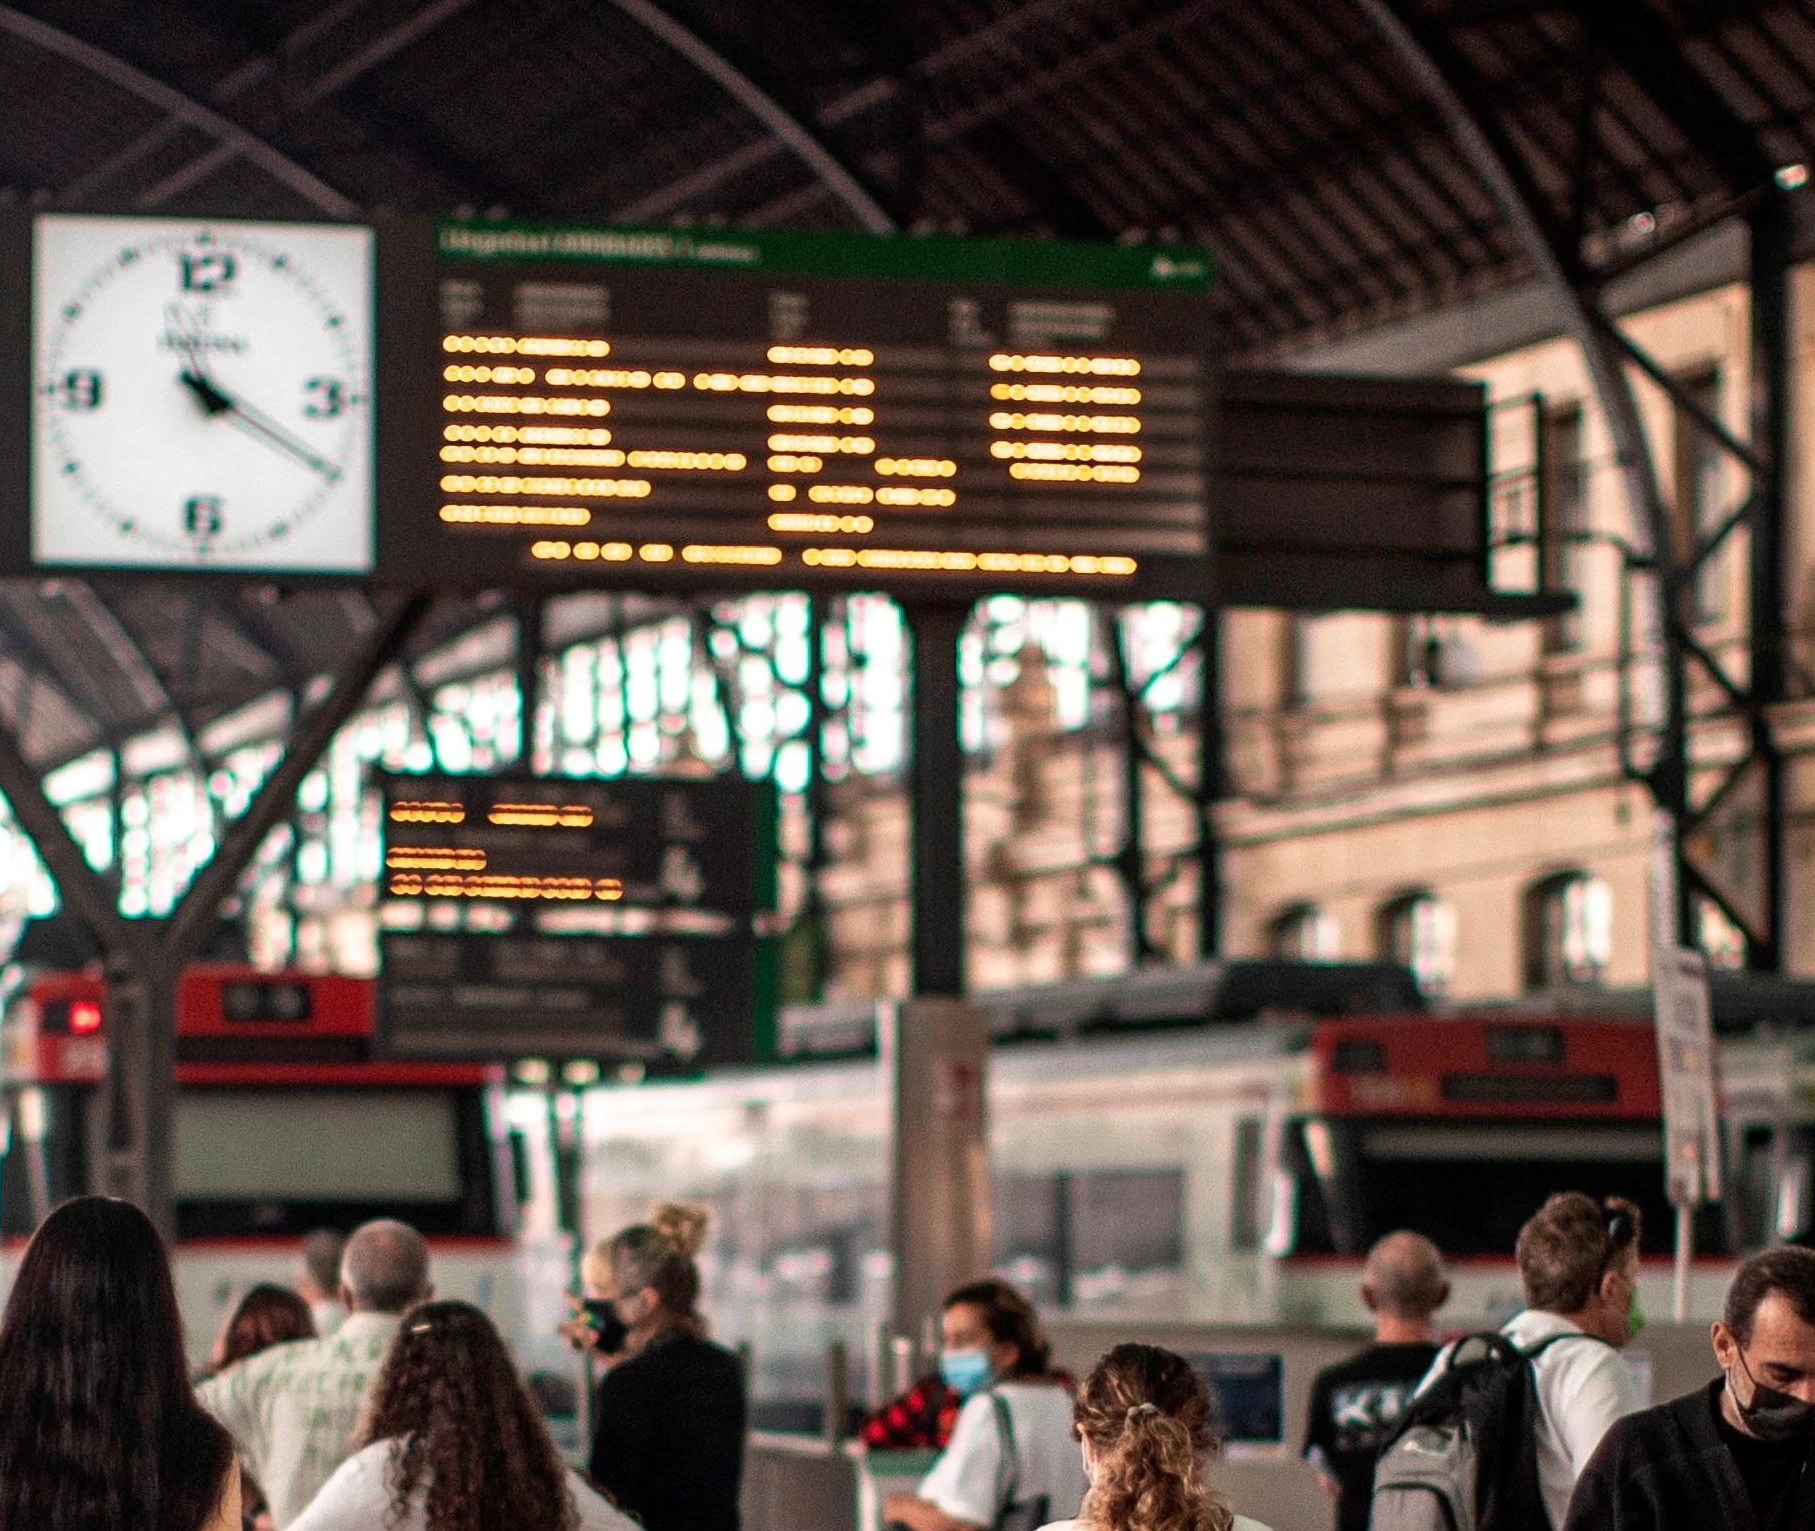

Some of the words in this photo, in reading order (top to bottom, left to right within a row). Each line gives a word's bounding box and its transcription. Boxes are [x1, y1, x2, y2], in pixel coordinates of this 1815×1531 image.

[181, 253, 238, 294] 12
[64, 368, 104, 411] 9
[304, 376, 342, 418] 3
[184, 495, 223, 535] 6
